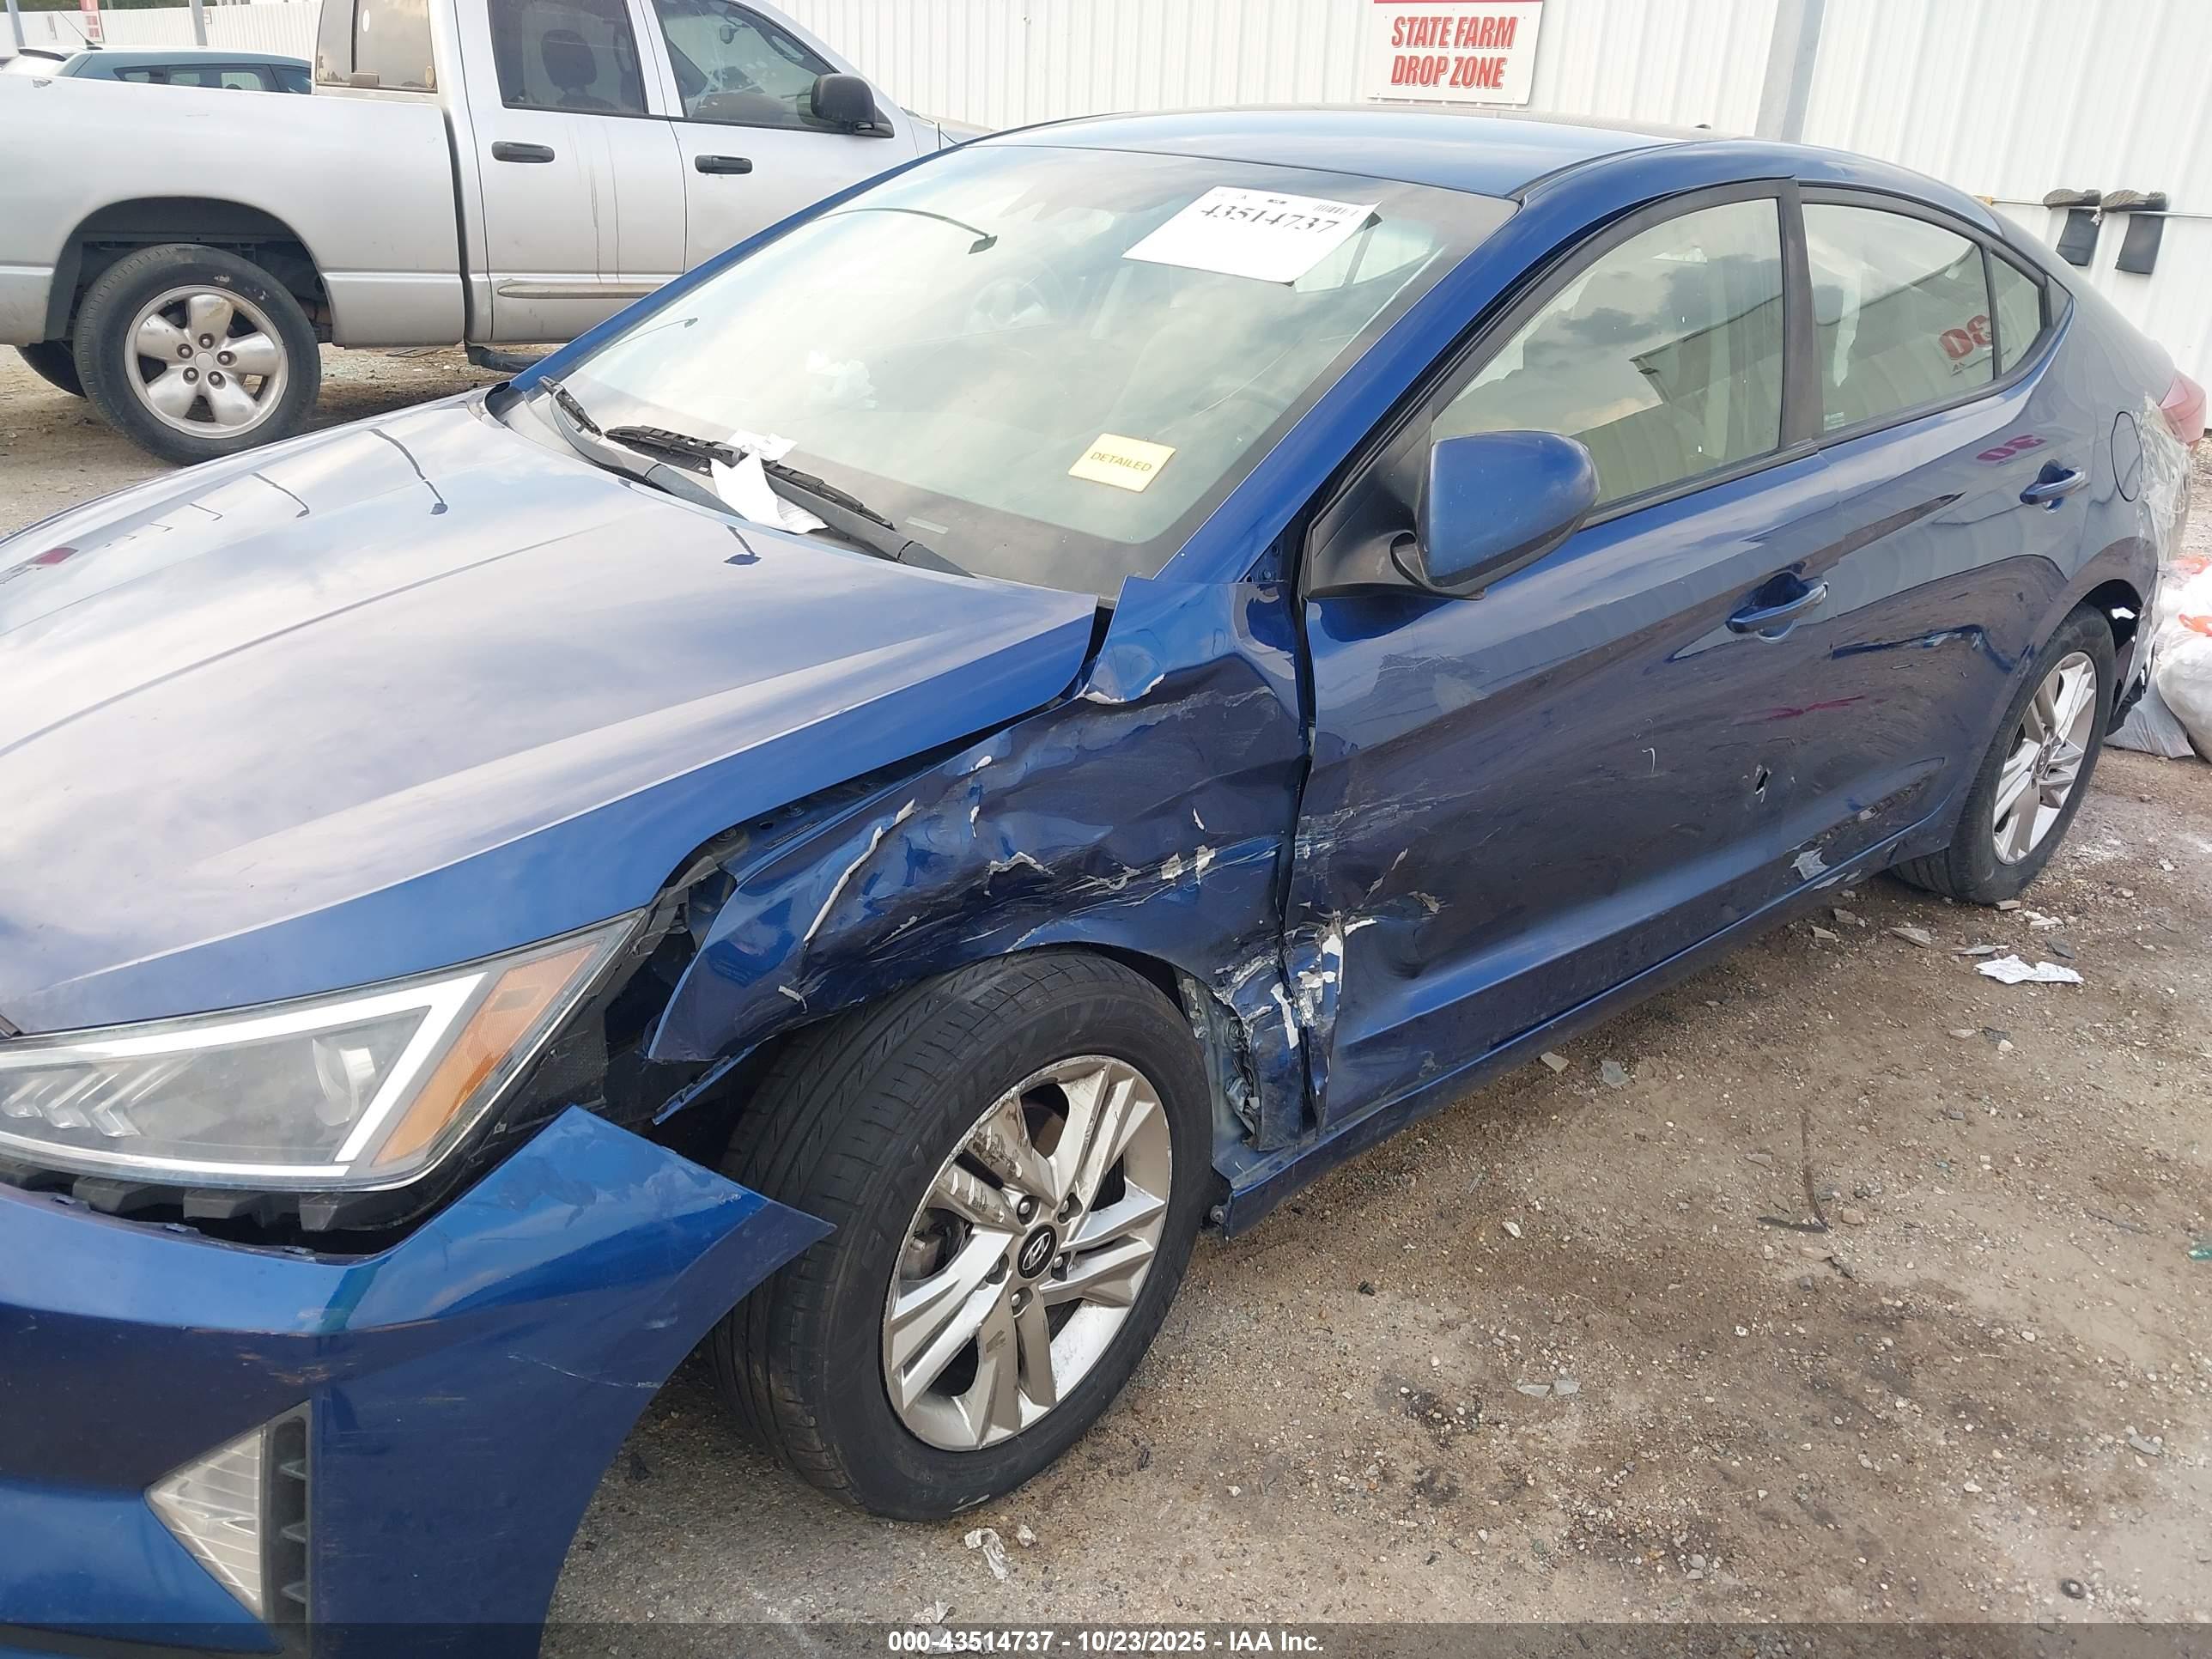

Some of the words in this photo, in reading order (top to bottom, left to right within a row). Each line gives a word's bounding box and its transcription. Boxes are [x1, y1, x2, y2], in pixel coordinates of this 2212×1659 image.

[1391, 16, 1453, 48] STATE
[1453, 16, 1518, 49] FARM
[1390, 55, 1449, 87] DROP
[1449, 56, 1508, 89] ZONE
[1200, 204, 1340, 233] 43514737
[1091, 452, 1152, 471] DETAILED
